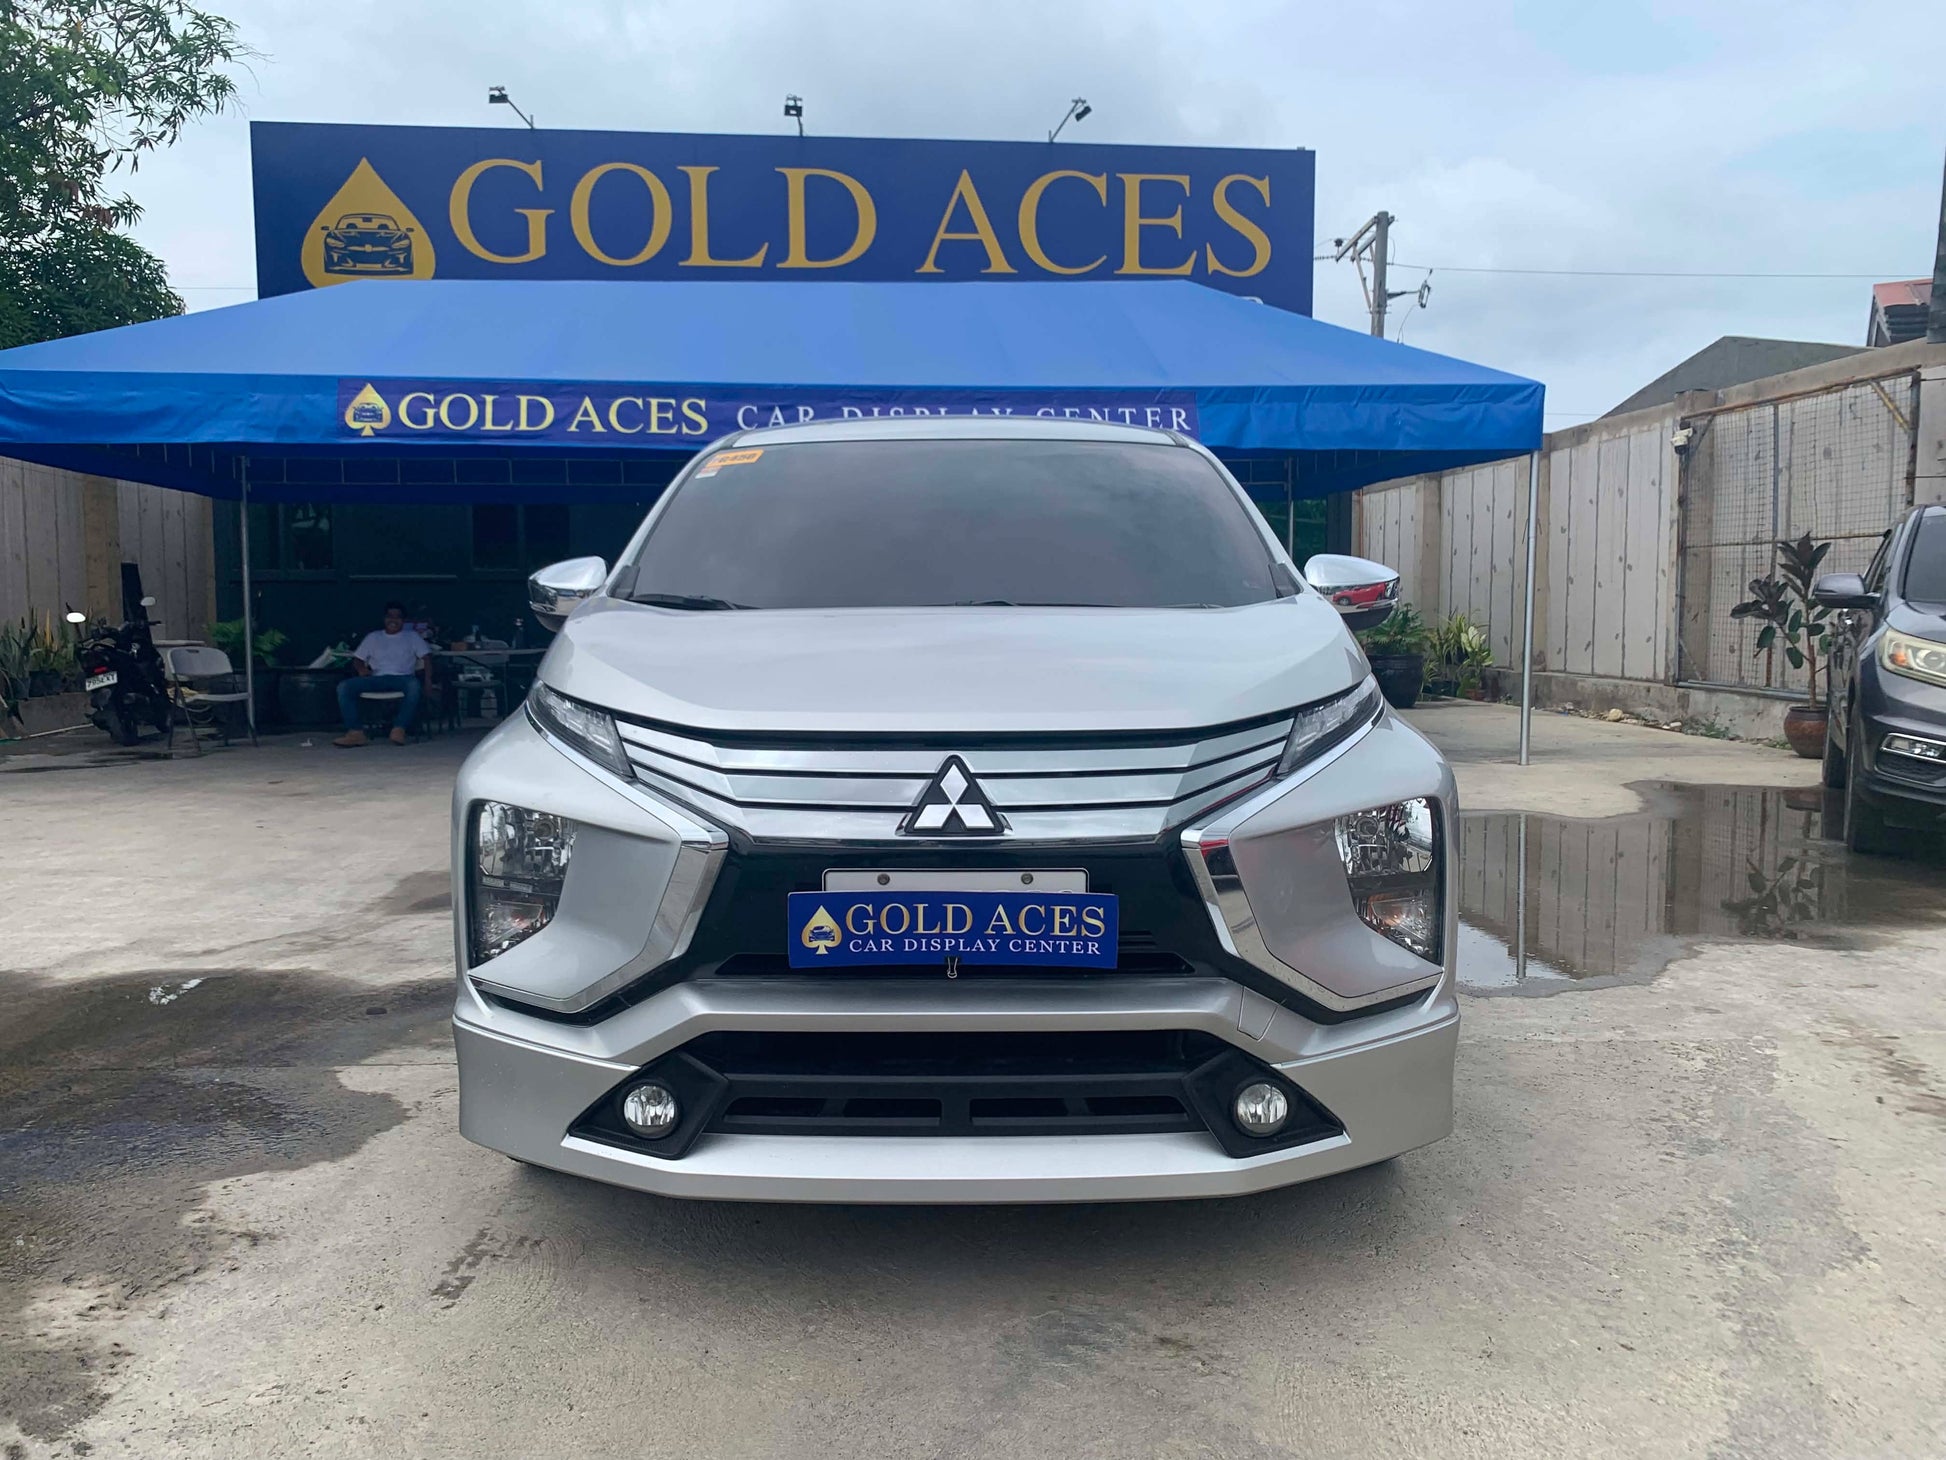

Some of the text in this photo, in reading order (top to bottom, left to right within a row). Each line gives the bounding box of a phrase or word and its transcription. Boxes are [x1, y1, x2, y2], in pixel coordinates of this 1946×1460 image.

[448, 158, 1272, 278] GOLD ACES
[398, 392, 555, 431] GOLD
[566, 395, 710, 436] ACES
[736, 405, 815, 431] CAR
[845, 903, 1106, 938] GOLD ACES
[849, 938, 1101, 955] CAR DISPLAY CENTER
